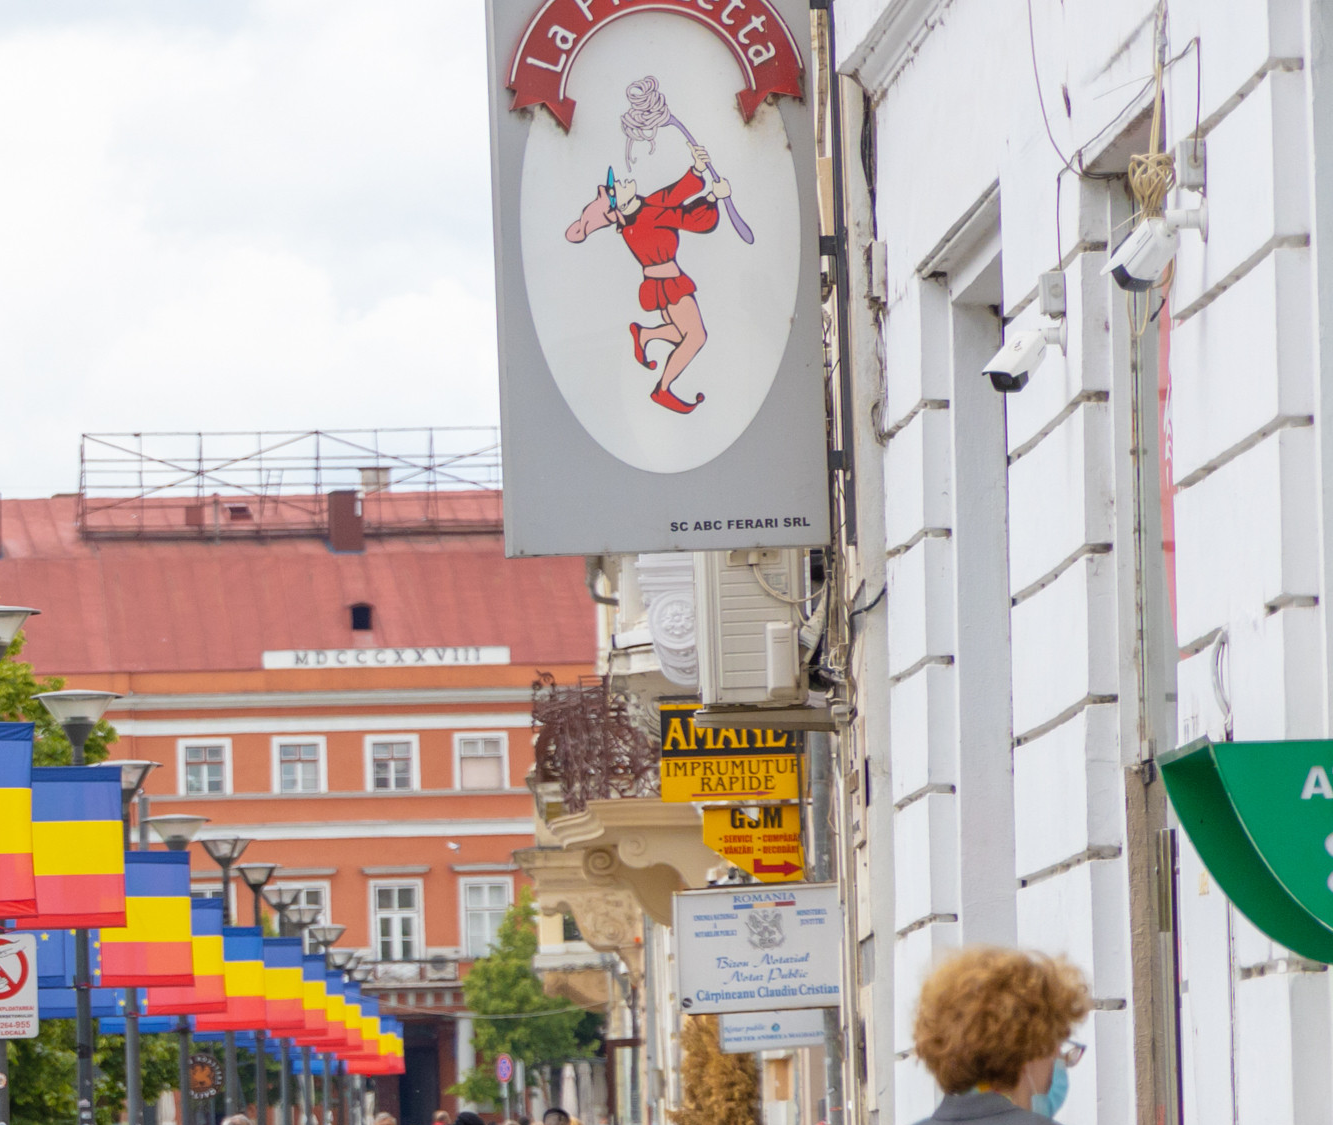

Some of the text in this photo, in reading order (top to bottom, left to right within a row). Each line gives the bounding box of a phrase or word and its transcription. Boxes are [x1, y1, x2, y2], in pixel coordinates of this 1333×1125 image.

[526, 24, 577, 73] La
[670, 517, 810, 532] SC ABC FERARI SRL
[663, 717, 803, 750] AMANE
[701, 775, 775, 792] RAPIDE
[723, 835, 753, 843] SERVICE
[767, 967, 809, 983] Public
[757, 985, 798, 998] Claudiu
[798, 983, 840, 996] Cristian
